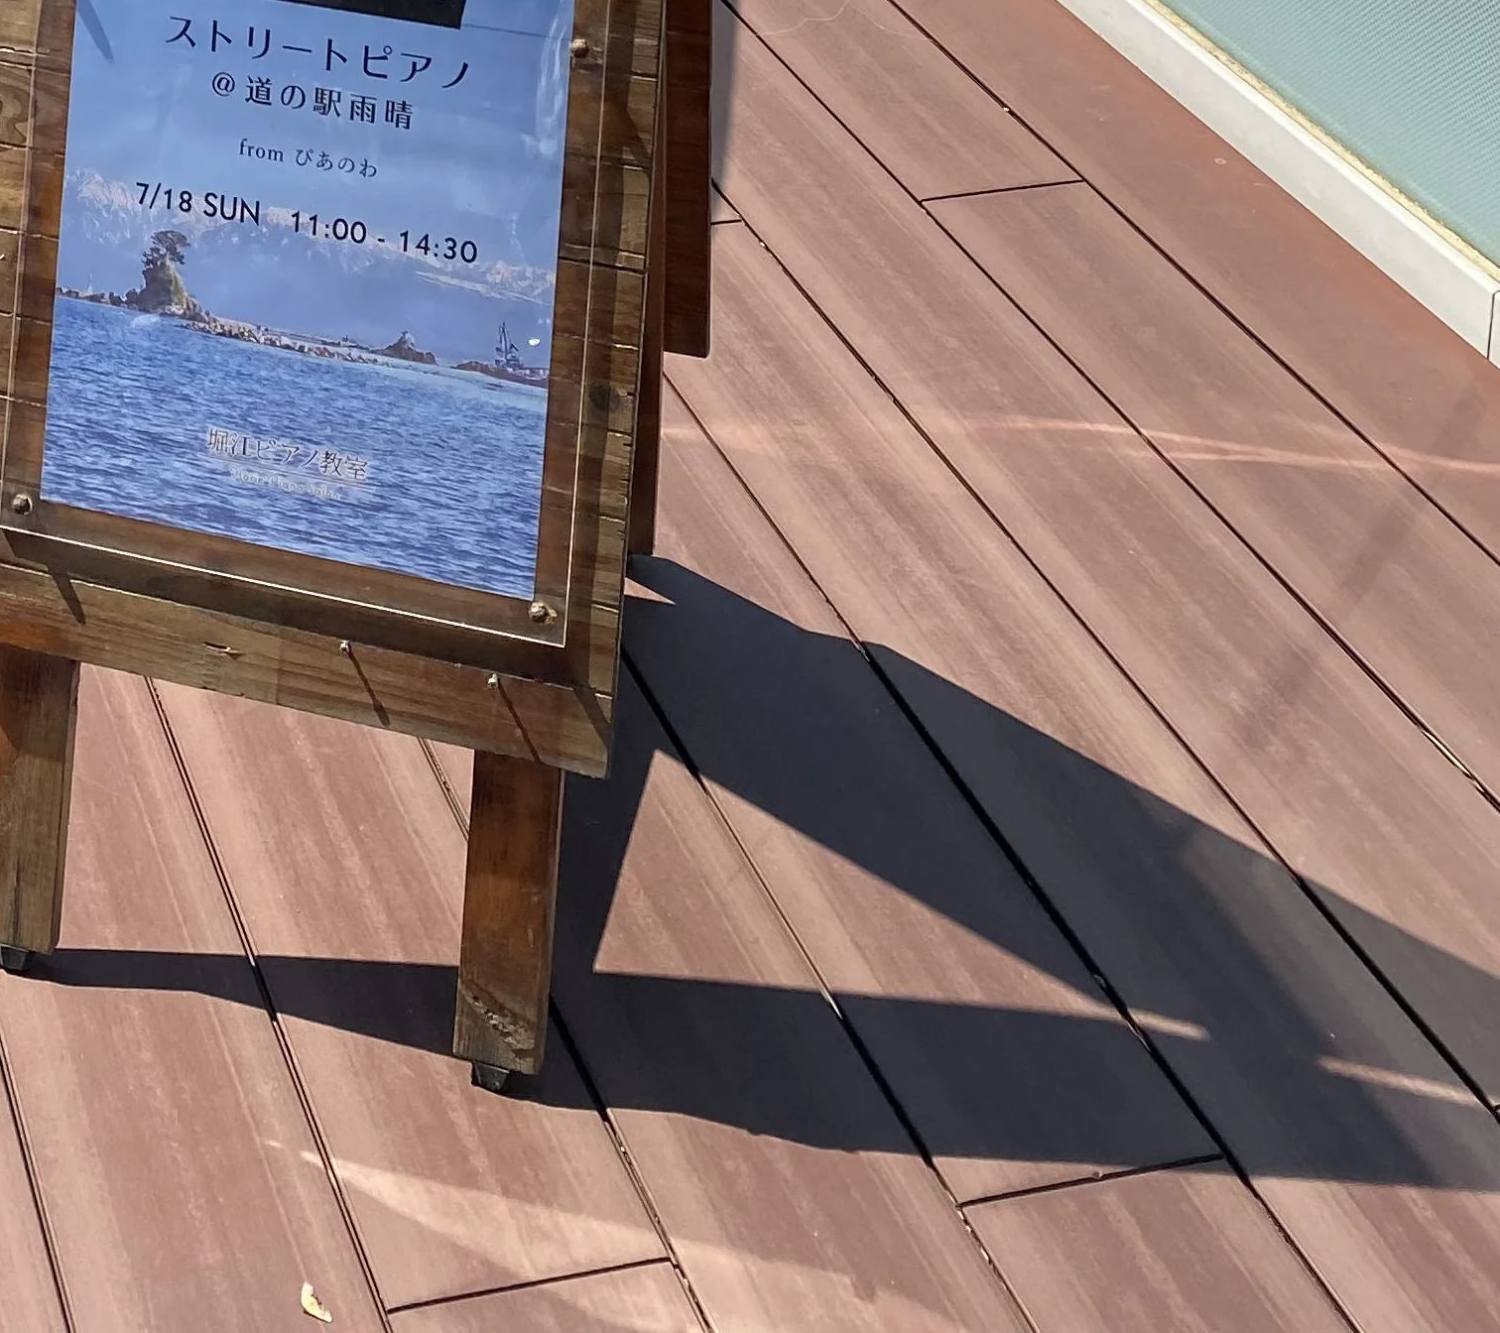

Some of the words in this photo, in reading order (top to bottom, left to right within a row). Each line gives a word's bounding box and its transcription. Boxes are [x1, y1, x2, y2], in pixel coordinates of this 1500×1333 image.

[165, 16, 469, 89] ストリートピアノ
[239, 139, 284, 163] from
[295, 148, 377, 178] ぴあのわ
[136, 182, 192, 213] 7/18
[202, 192, 260, 226] SUN
[291, 210, 368, 245] 11:00
[399, 230, 478, 264] 14:30
